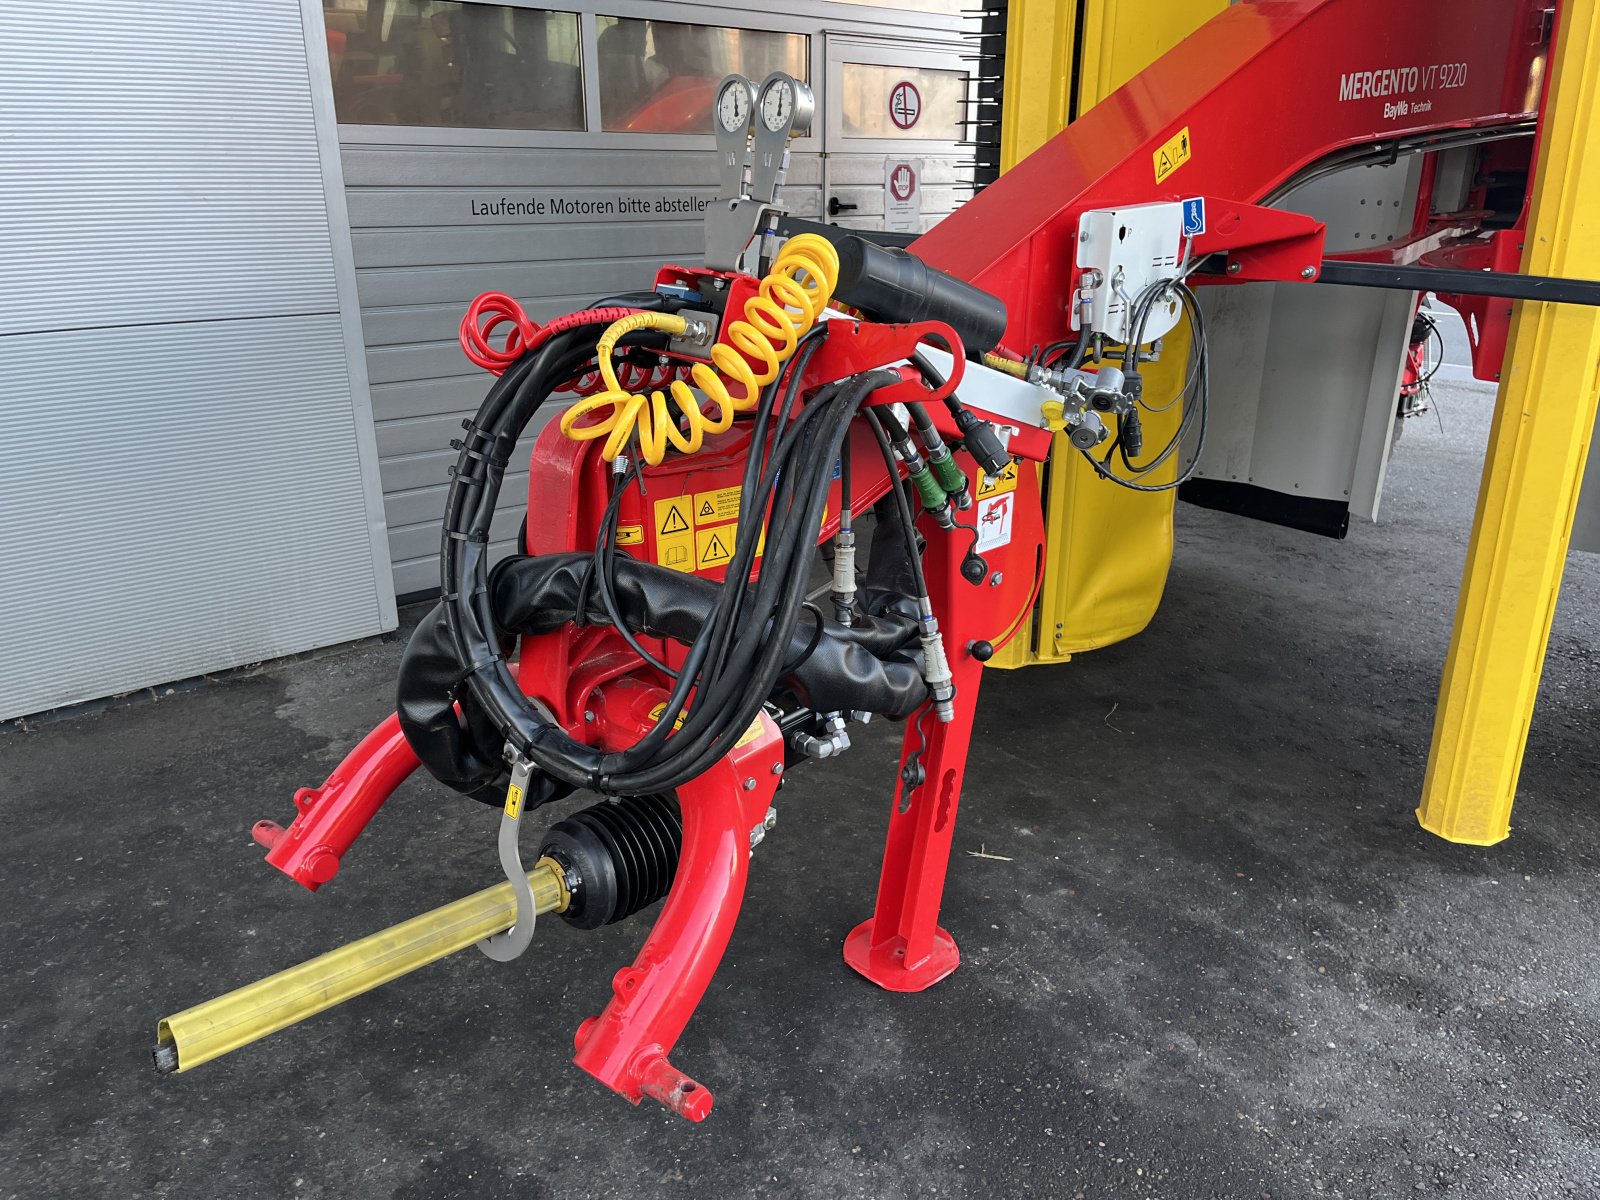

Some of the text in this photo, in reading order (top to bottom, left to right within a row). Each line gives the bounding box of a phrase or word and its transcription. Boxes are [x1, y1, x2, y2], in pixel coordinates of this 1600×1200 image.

[1339, 63, 1467, 102] MERGENTO VT 9220
[1384, 100, 1432, 120] BayWa Technik
[471, 197, 545, 215] Laufende
[550, 197, 613, 215] Motoren
[618, 197, 650, 214] bitte
